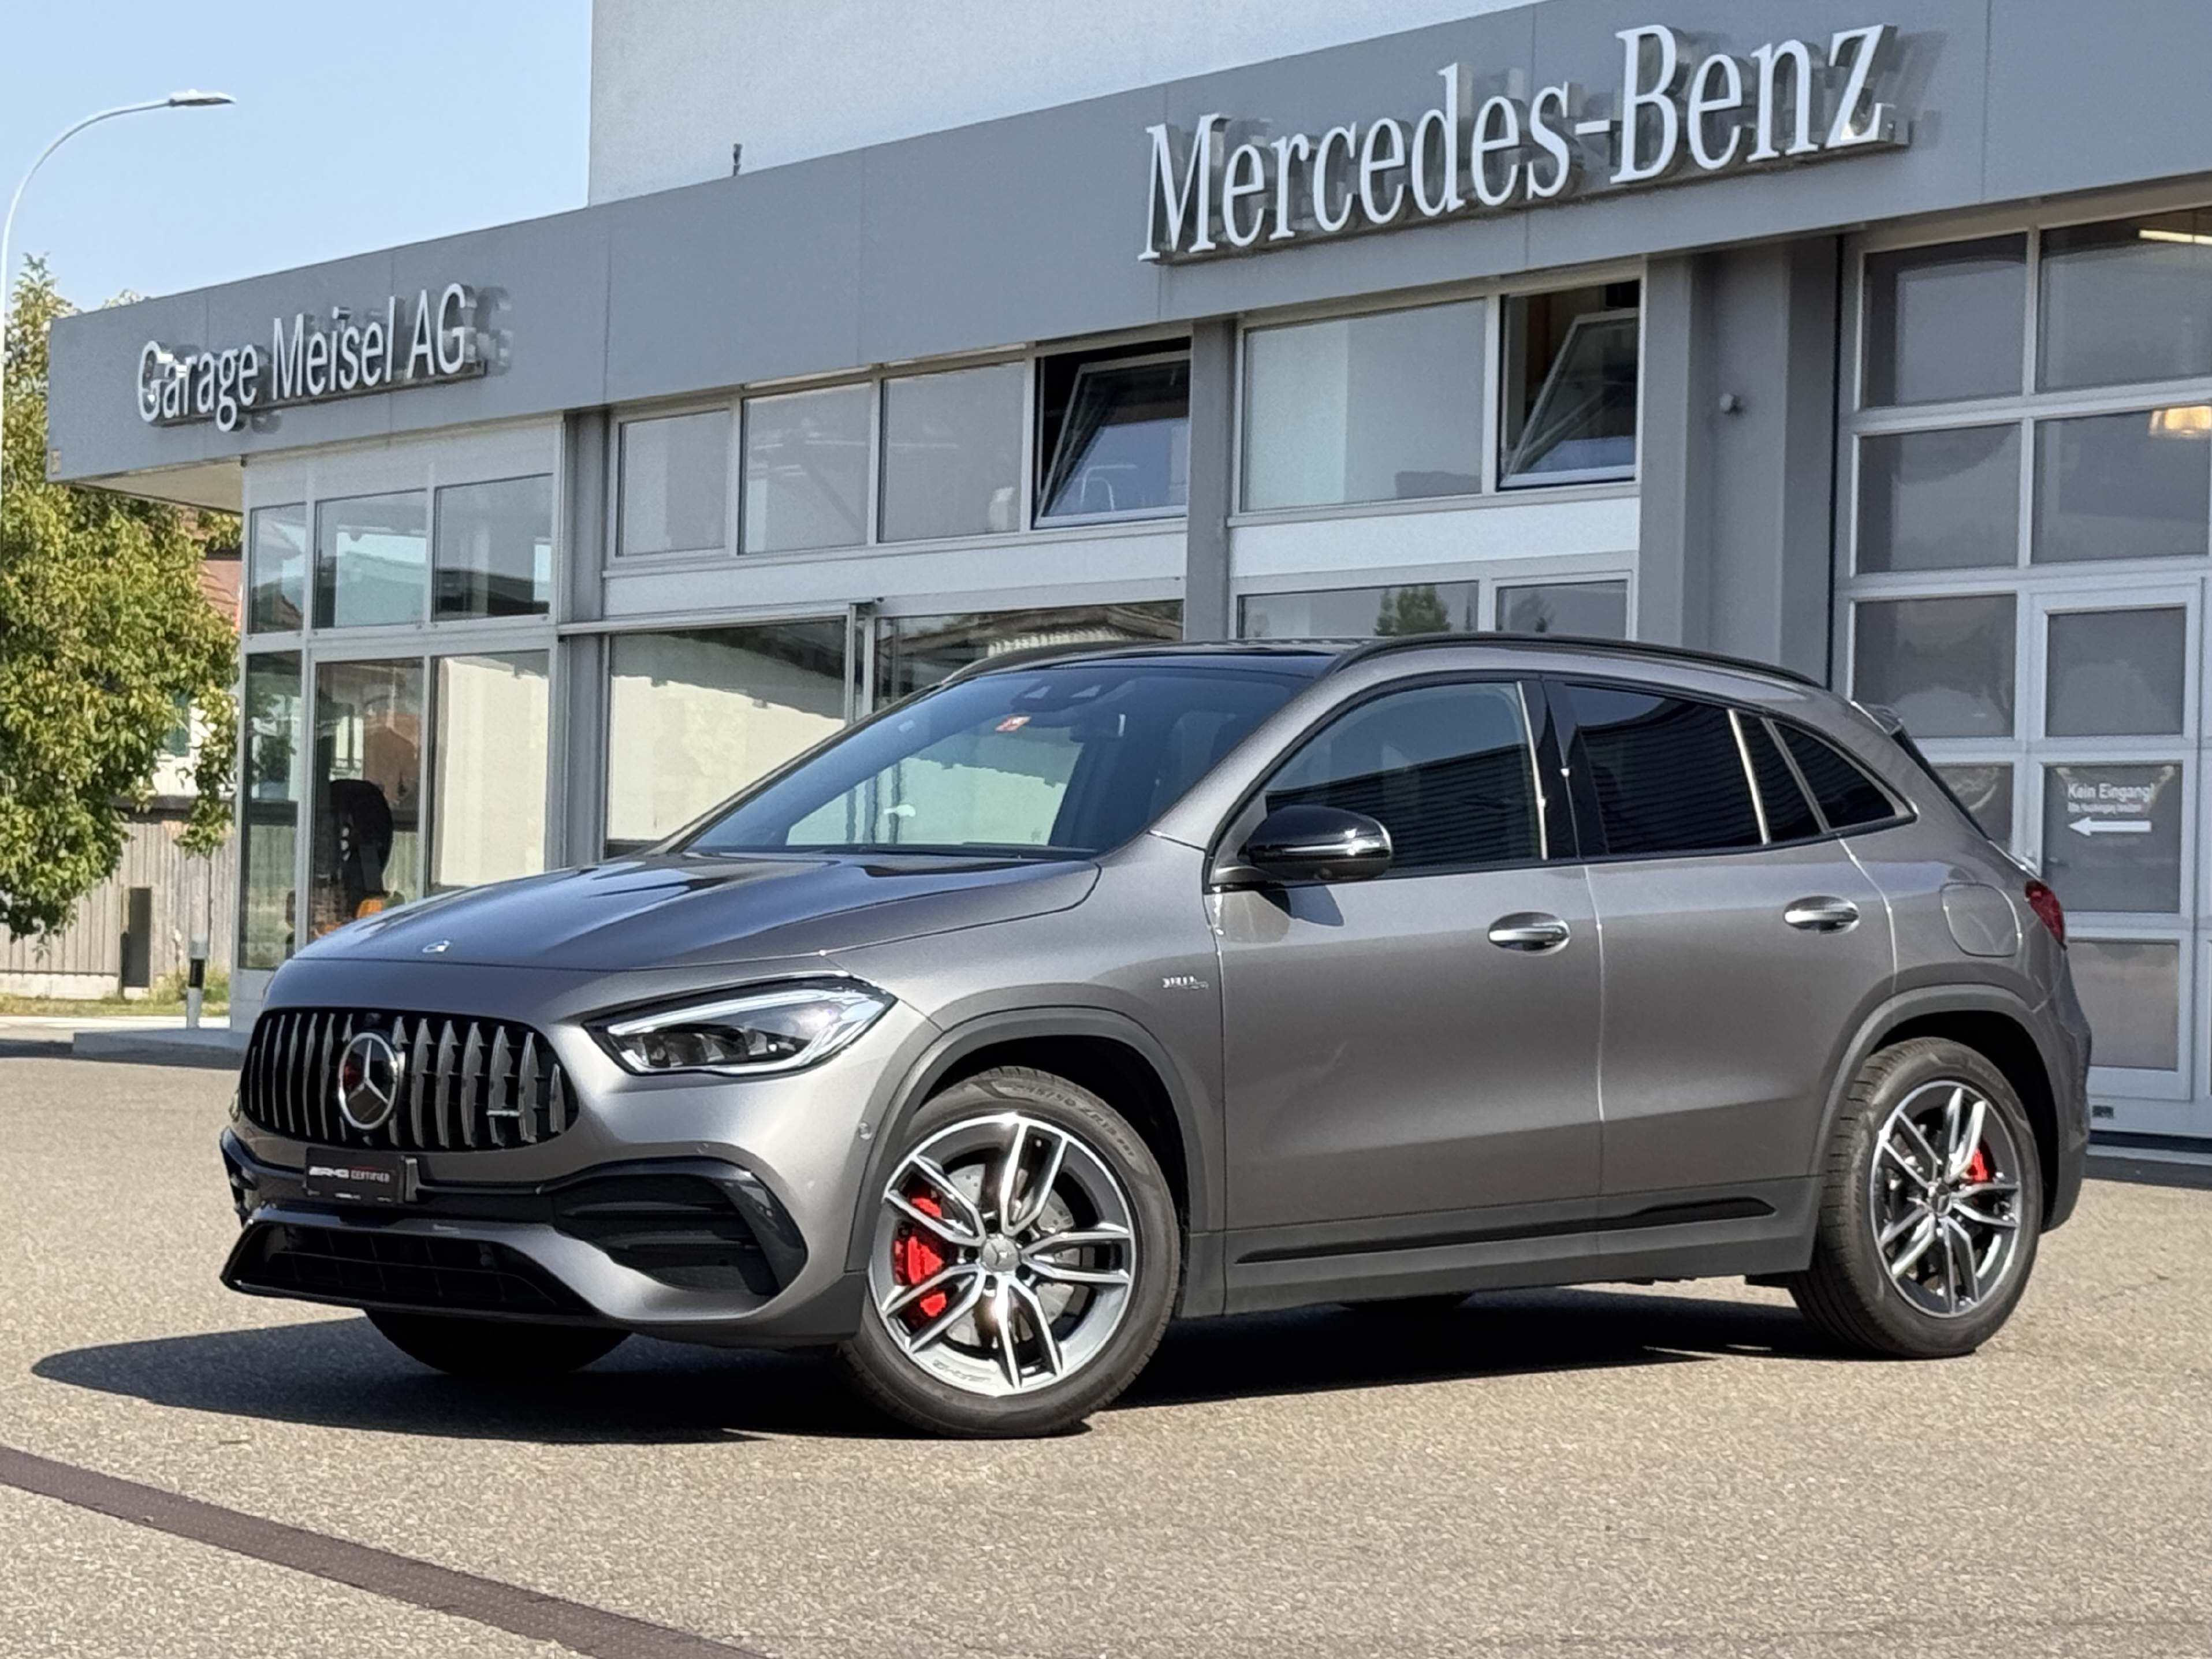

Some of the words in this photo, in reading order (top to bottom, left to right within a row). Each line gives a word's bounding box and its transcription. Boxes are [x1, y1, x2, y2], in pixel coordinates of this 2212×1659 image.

[1138, 24, 1895, 262] Mercedes-Benz
[137, 341, 258, 431] Garage
[272, 296, 396, 400] Meisel
[407, 283, 467, 379] AG
[2068, 783, 2095, 799] Kein
